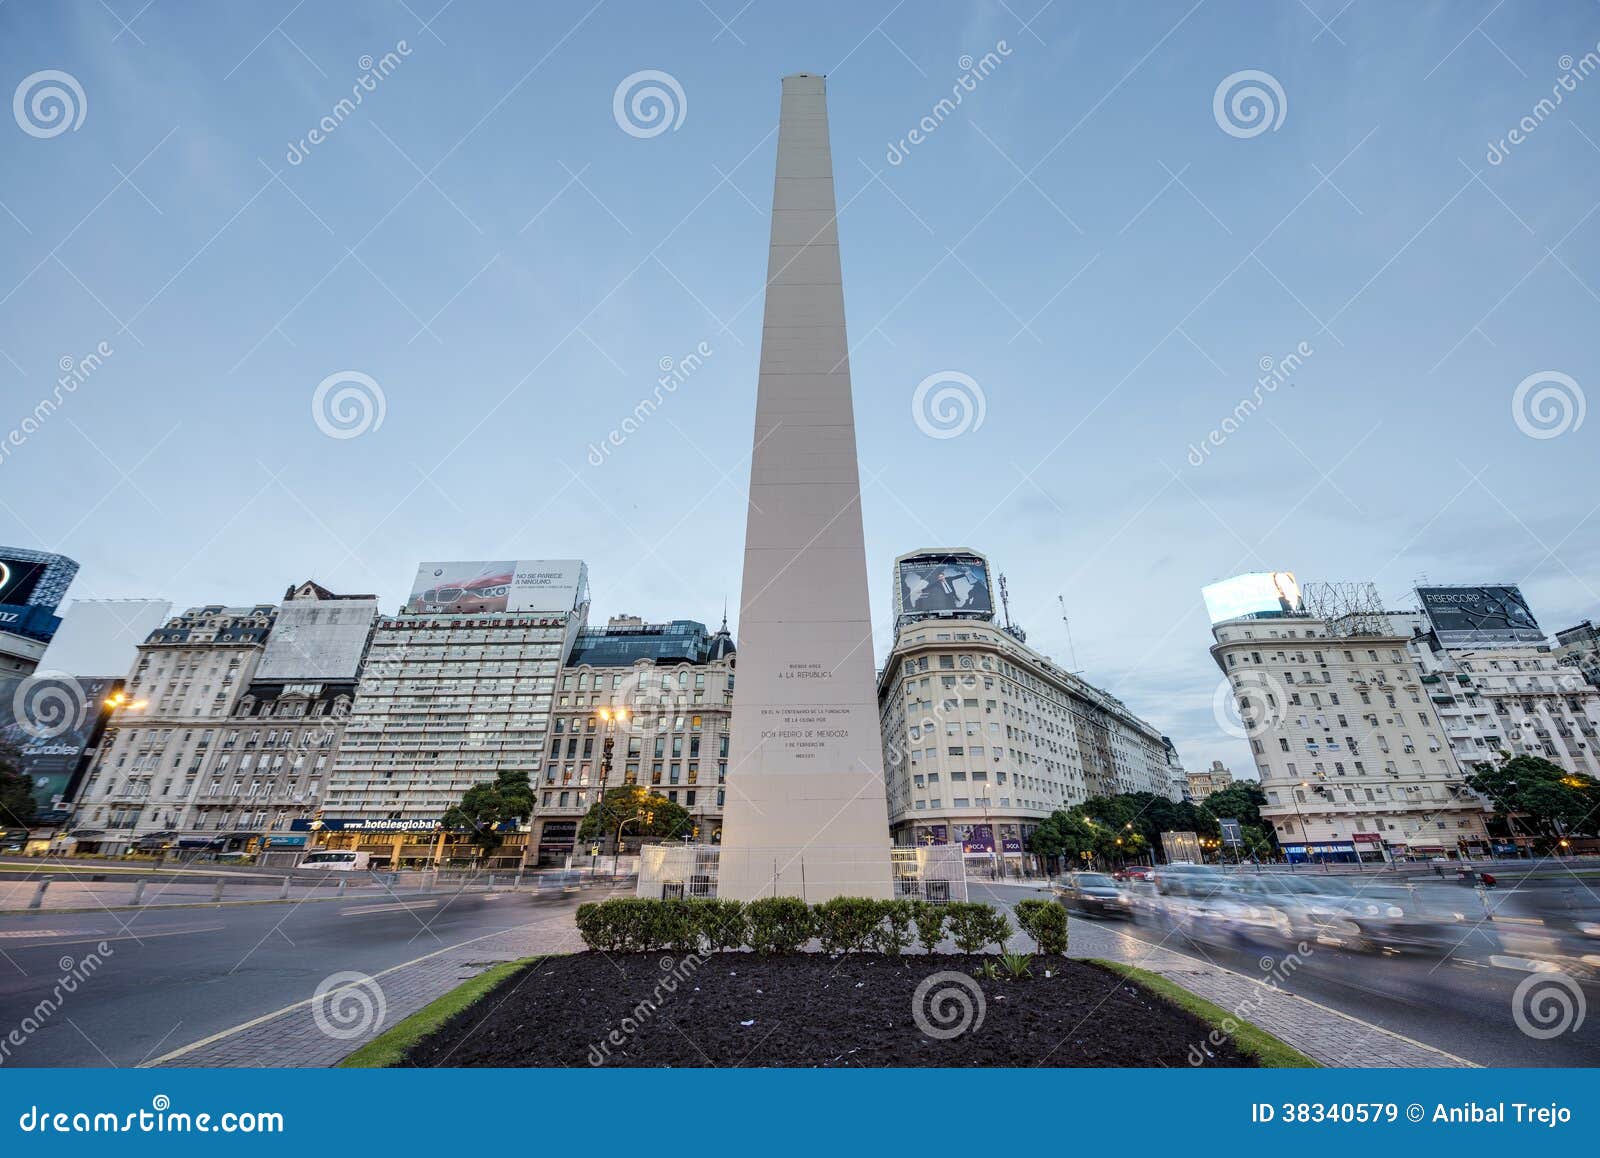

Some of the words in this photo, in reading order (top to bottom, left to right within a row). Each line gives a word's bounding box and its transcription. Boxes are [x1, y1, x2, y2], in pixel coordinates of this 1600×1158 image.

[1426, 594, 1480, 603] FIBERCORP
[778, 671, 783, 679] A
[785, 671, 795, 679] LA
[797, 671, 832, 679] REPUBLICA
[761, 730, 776, 738] DON
[779, 730, 803, 738] PEDRO
[804, 730, 813, 738] DE
[816, 729, 849, 738] MENDOZA
